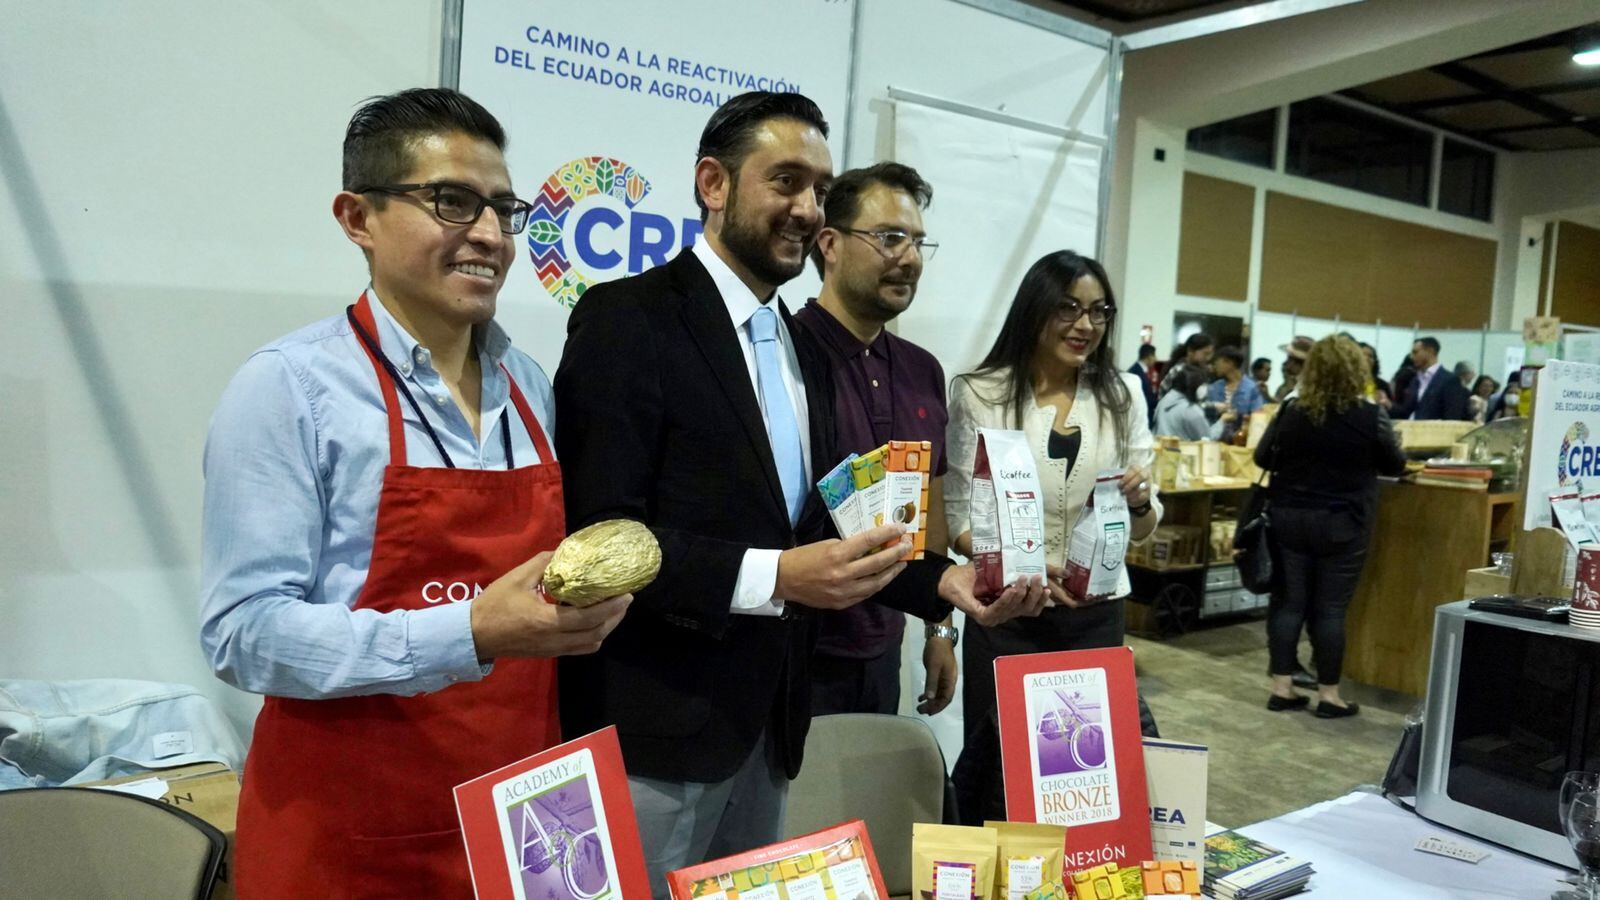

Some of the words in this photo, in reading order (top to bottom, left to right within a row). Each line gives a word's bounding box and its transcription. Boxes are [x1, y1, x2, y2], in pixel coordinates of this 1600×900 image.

[494, 46, 536, 70] DEL
[543, 57, 642, 93] ECUADOR
[526, 26, 610, 58] CAMINO
[616, 47, 630, 64] A
[636, 51, 661, 71] LA
[667, 57, 800, 94] REACTIVACIÓN
[1031, 673, 1087, 688] ACADEMY
[504, 761, 571, 802] ACADEMY
[1041, 773, 1110, 792] CHOCOLATE
[1042, 785, 1112, 814] BRONZE
[1044, 809, 1088, 825] WINNER
[1090, 807, 1113, 819] 2018
